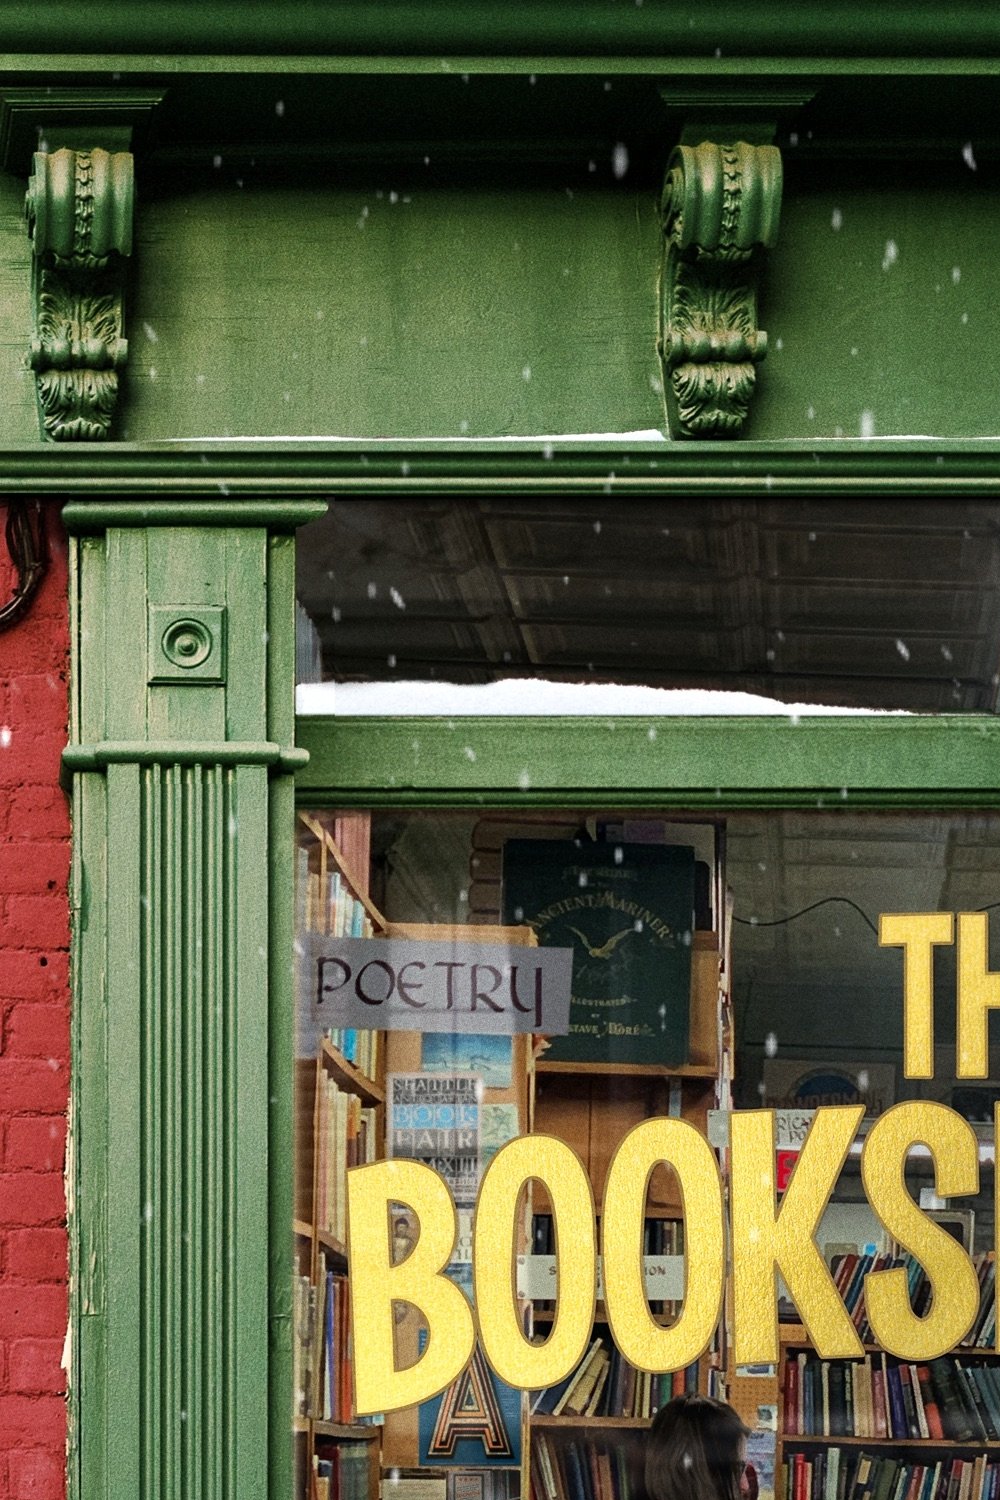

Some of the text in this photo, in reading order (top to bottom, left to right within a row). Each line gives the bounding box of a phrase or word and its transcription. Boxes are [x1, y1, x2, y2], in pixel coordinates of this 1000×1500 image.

[526, 891, 671, 939] ANCIENT MARINER
[316, 956, 543, 1027] POETRY
[393, 1105, 477, 1128] BOOK
[395, 1130, 474, 1149] FAIR
